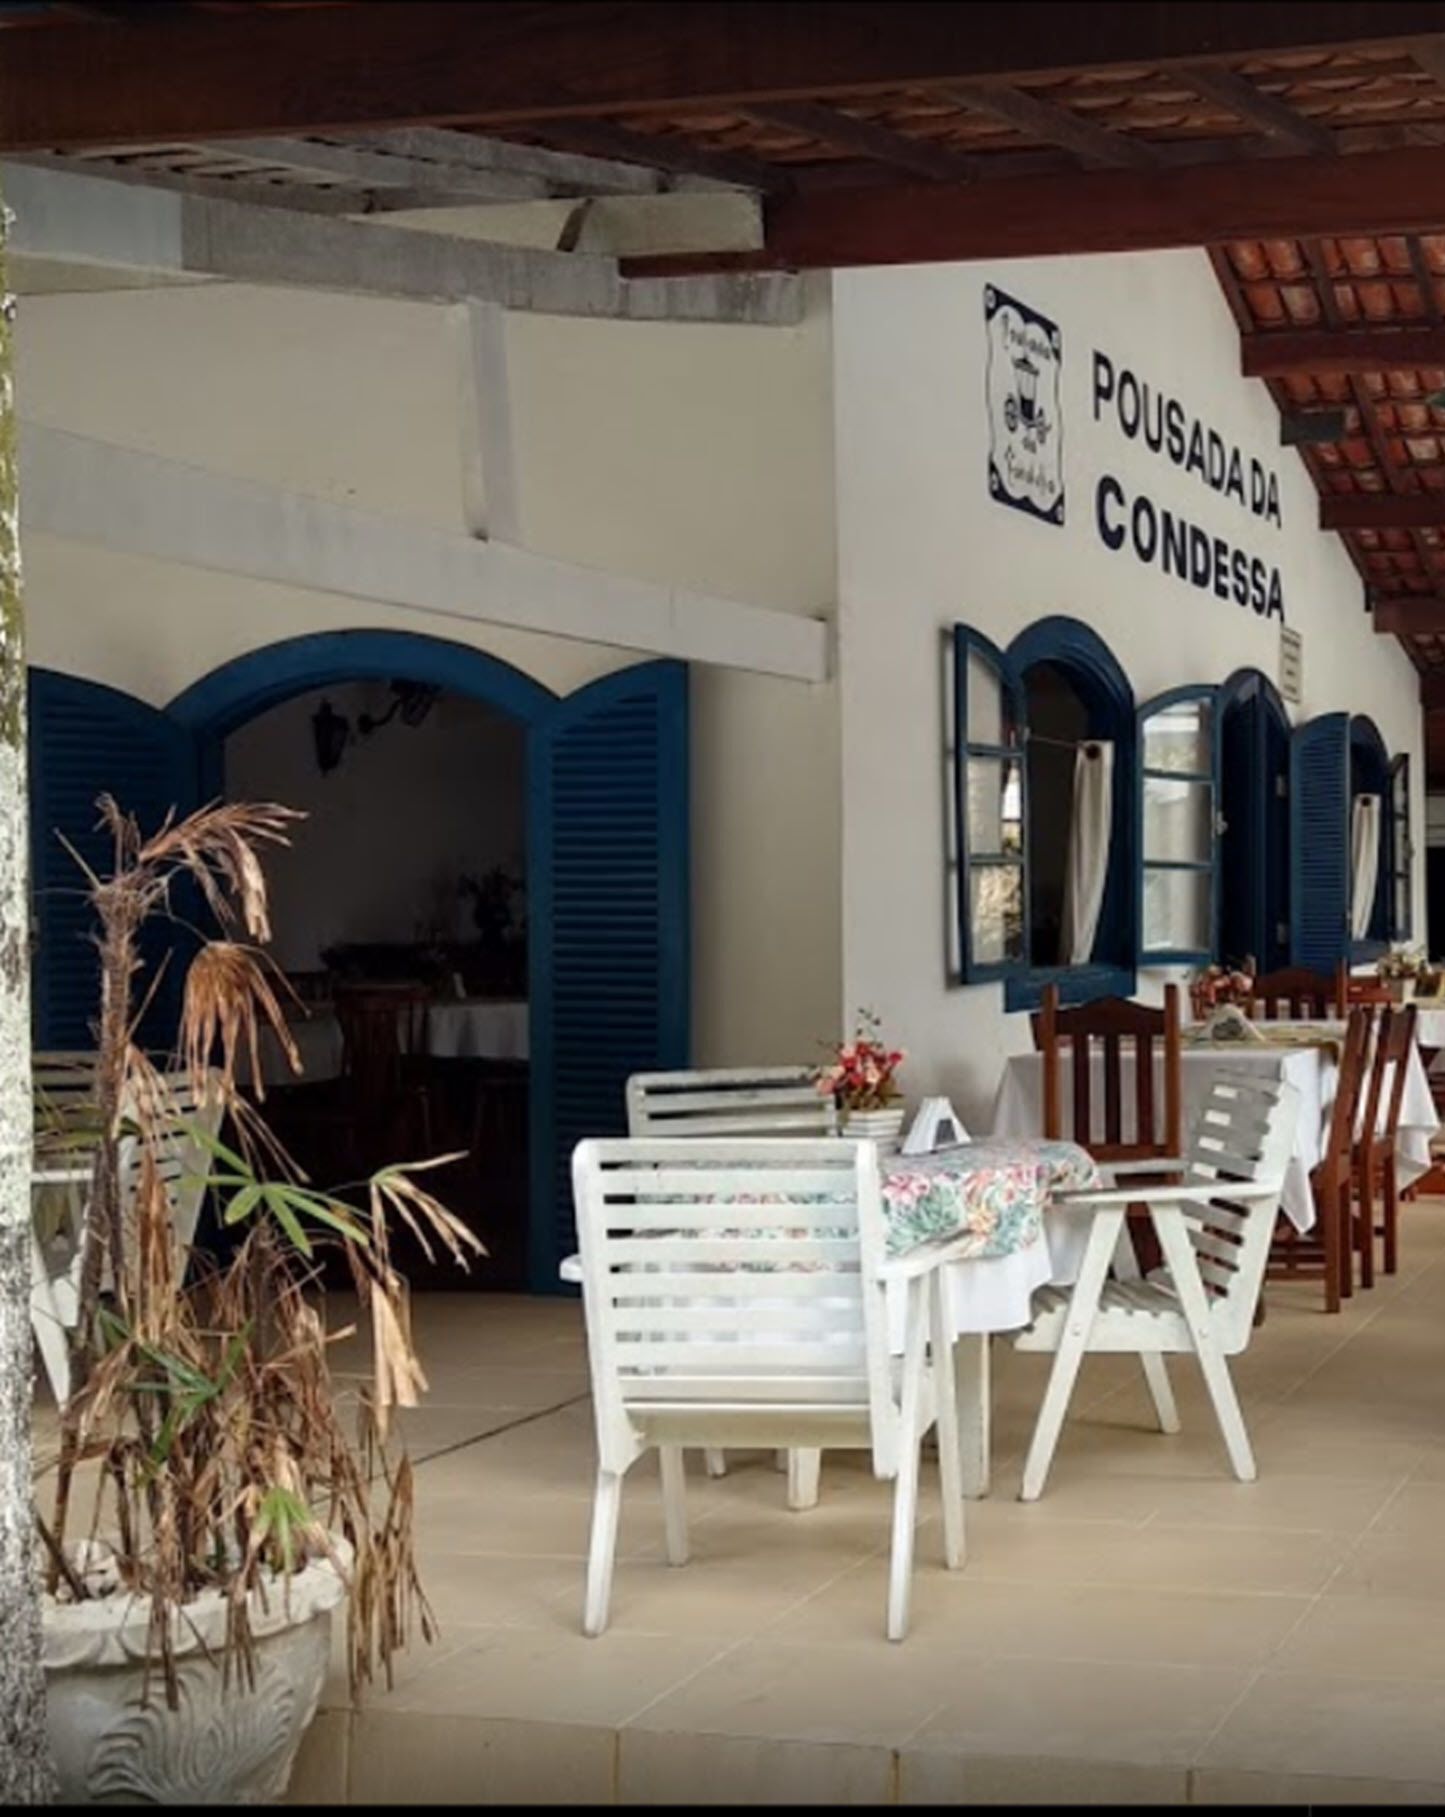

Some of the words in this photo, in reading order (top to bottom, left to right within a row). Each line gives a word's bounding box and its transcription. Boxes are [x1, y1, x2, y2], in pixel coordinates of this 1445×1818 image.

[1093, 350, 1245, 506] POUSADA
[1251, 458, 1282, 530] DA
[1095, 475, 1285, 625] CONDESSA
